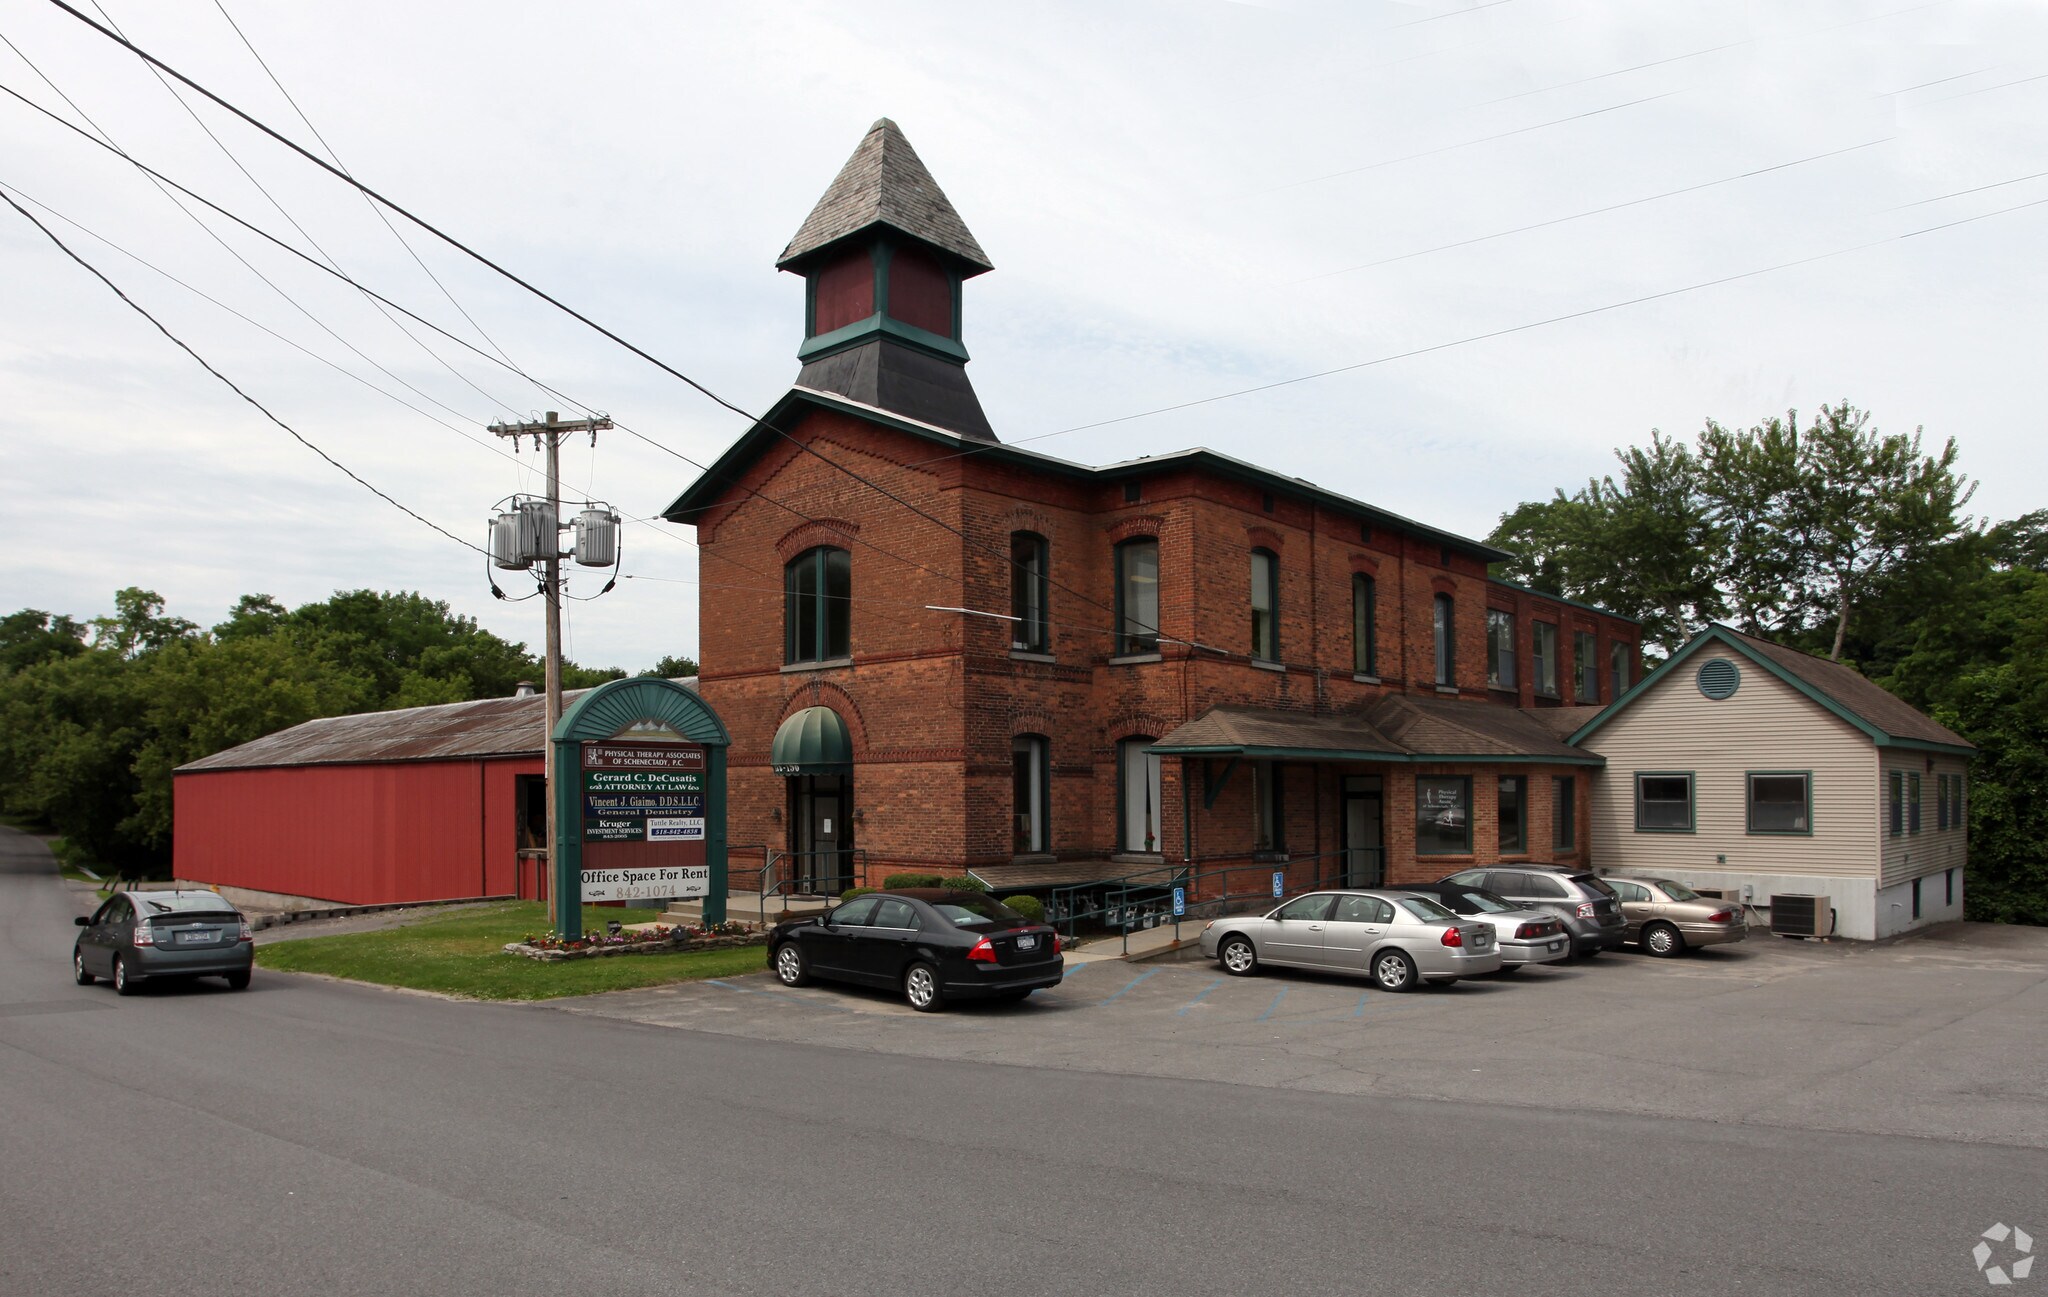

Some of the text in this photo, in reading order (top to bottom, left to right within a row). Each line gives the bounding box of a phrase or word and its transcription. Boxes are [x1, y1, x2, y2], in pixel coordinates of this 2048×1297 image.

[604, 750, 701, 760] PHYSICAL THERAPY ASSOCIATES
[593, 773, 697, 783] Gerard C. DeCusatis
[603, 783, 653, 791] ATTORNEY
[655, 783, 666, 791] AT
[589, 796, 618, 807] Vincent
[620, 796, 628, 807] J.
[599, 820, 632, 829] Kruger
[581, 868, 708, 885] Office Space For Rent
[616, 885, 676, 899] 842-1074
